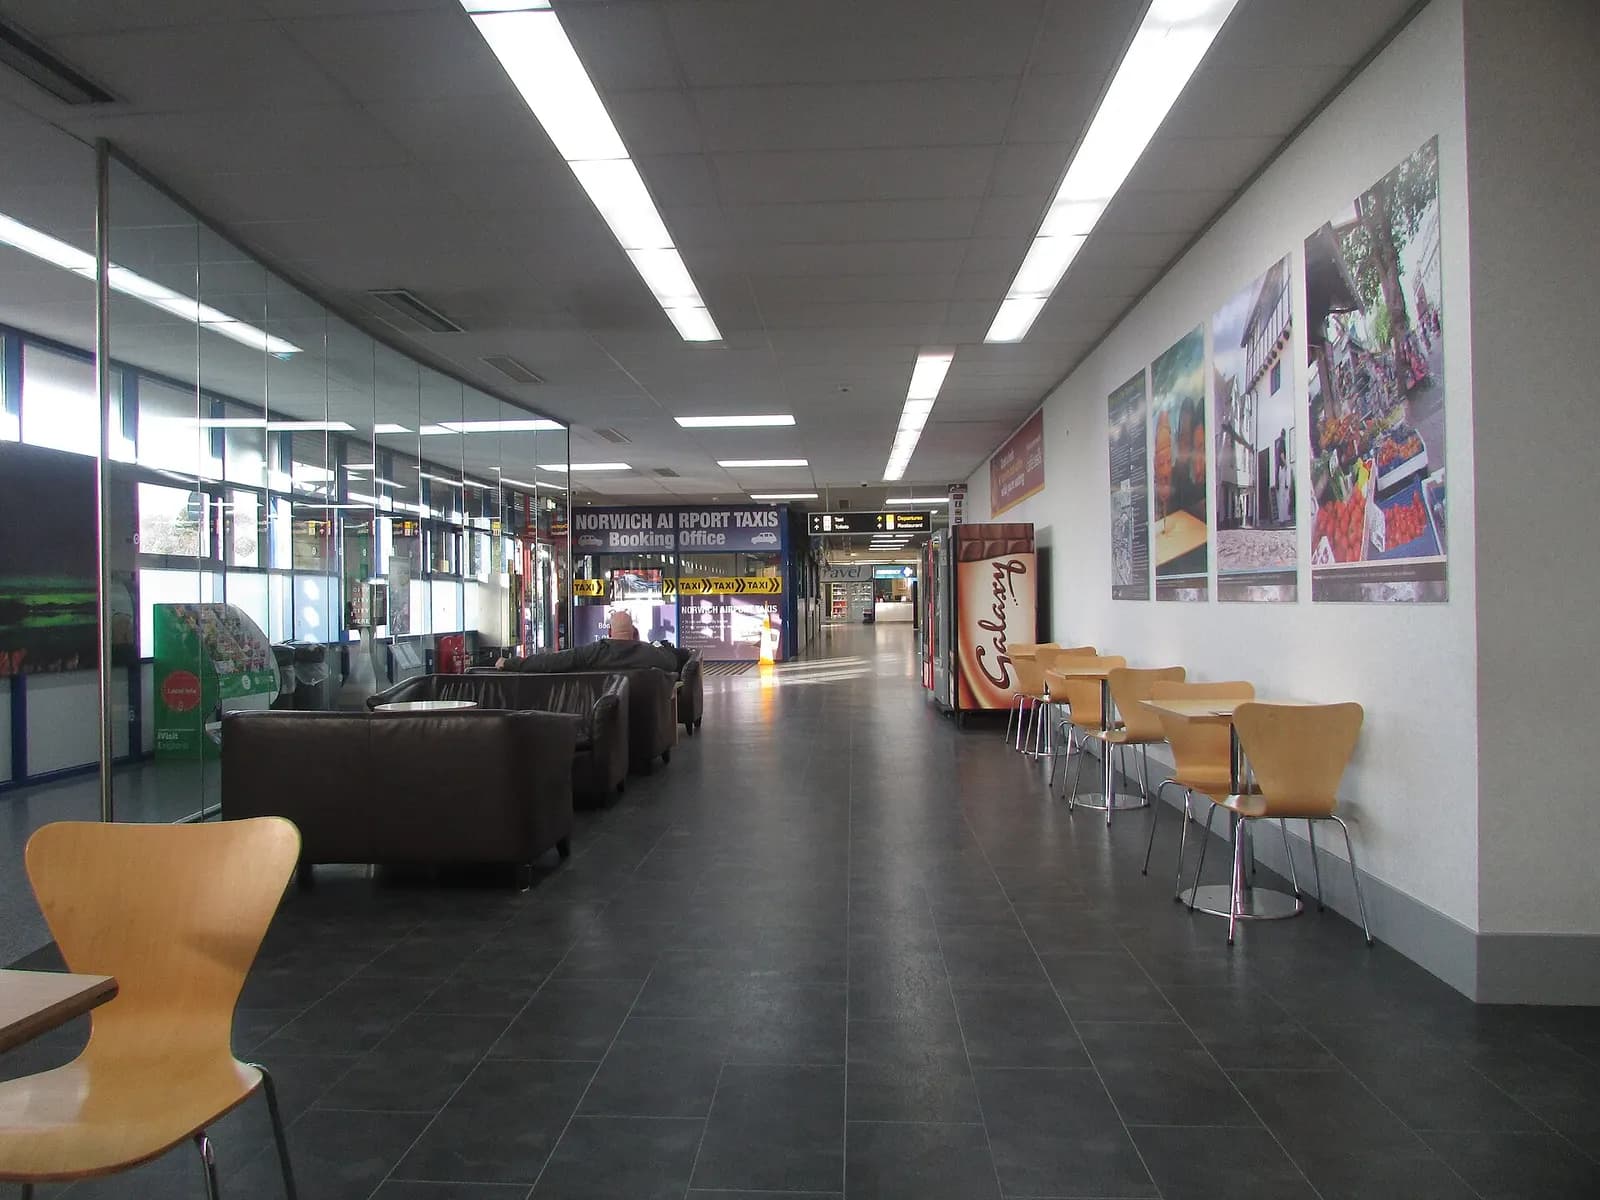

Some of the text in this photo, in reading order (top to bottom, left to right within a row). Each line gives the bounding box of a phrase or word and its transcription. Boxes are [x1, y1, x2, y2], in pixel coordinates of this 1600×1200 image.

[576, 513, 652, 530] NORWICH
[734, 511, 778, 527] TAXIS
[609, 531, 726, 549] Booking Office
[574, 583, 595, 592] TAXI
[680, 581, 768, 590] TAXI TAXI TAXI
[681, 605, 718, 615] NORWICH
[976, 559, 1027, 690] Galaxy
